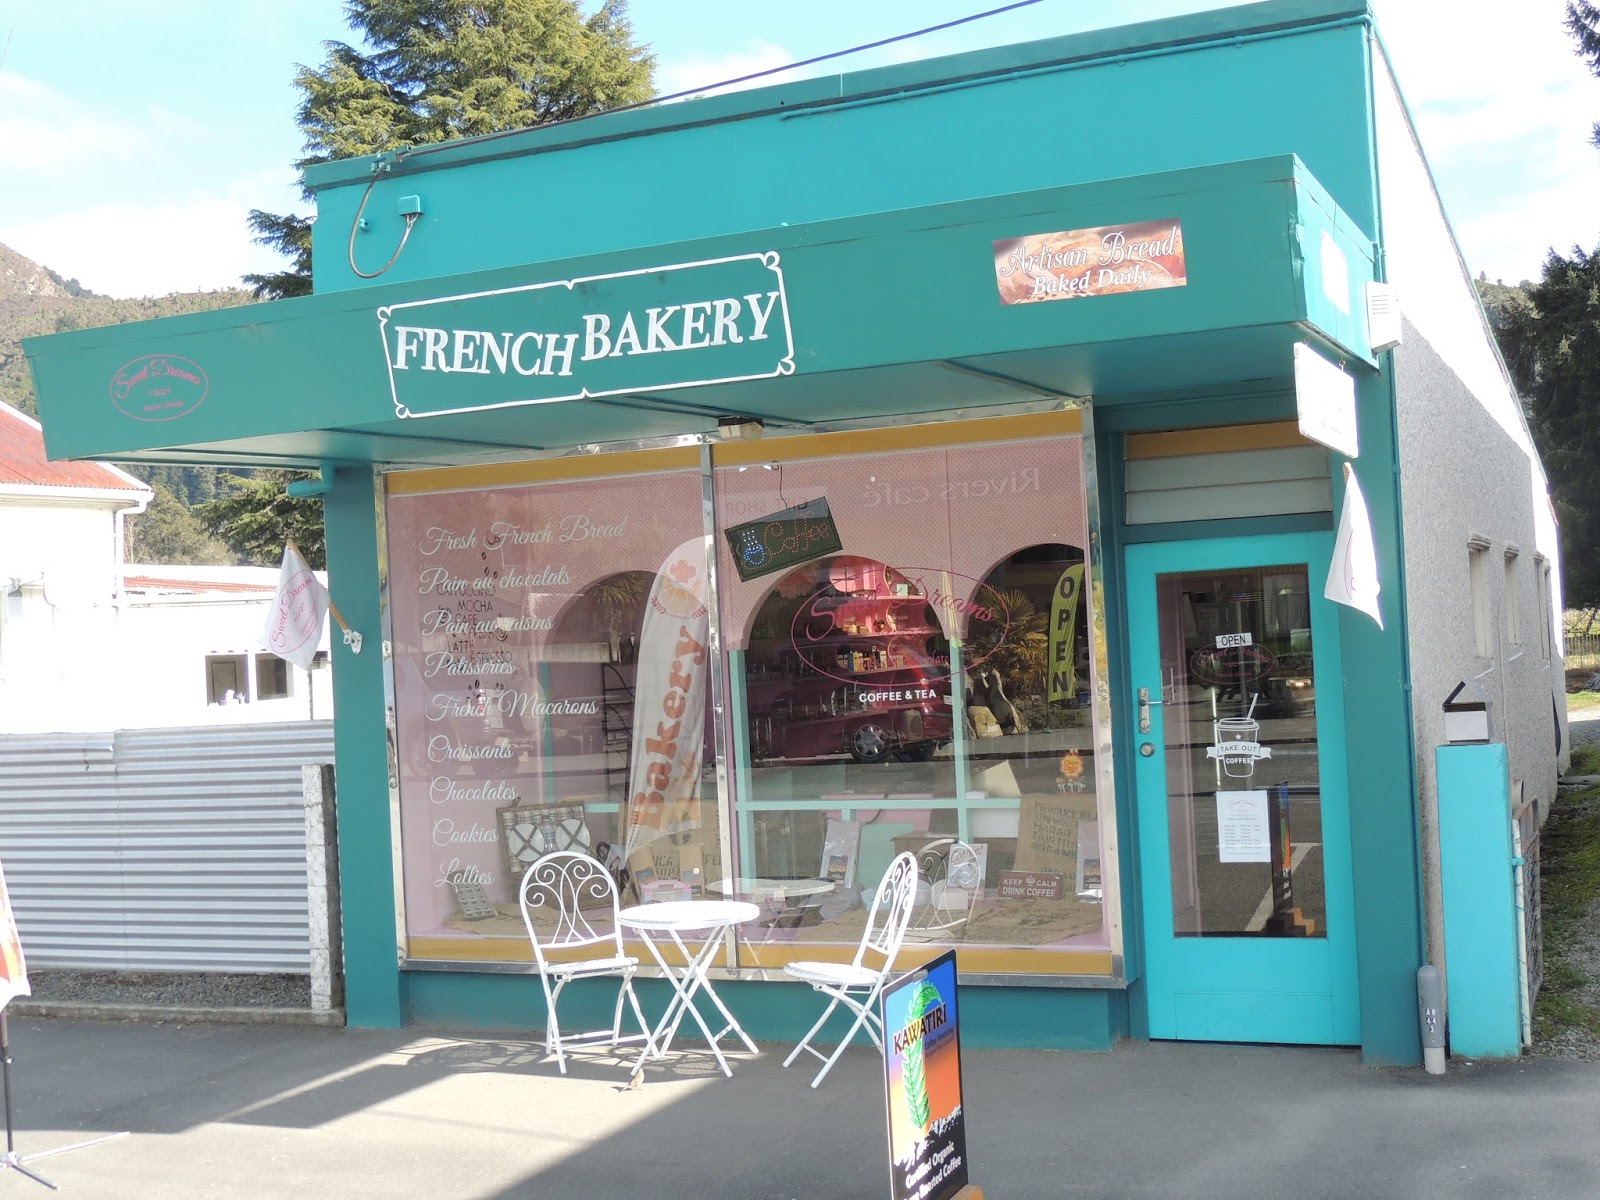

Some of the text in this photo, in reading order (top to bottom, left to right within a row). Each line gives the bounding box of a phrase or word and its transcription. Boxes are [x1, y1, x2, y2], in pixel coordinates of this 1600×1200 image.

[1000, 226, 1177, 277] Artisan Bread
[1033, 265, 1152, 295] Baked Daily
[393, 291, 779, 376] FRENCH BAKERY
[419, 514, 628, 555] Fresh French Bread
[419, 565, 573, 594] Pain au chocolats
[457, 599, 493, 613] MOCHA
[889, 574, 995, 622] Dreams
[422, 609, 469, 636] Pain
[475, 620, 497, 634] au
[498, 616, 556, 632] aisins
[1052, 576, 1076, 694] OPEN
[1221, 634, 1246, 646] OPEN
[424, 651, 515, 677] Patisseries
[425, 690, 599, 721] French Macarons
[859, 689, 937, 702] COFFEE & TEA
[633, 625, 705, 830] Bakery
[428, 734, 514, 762] Croissants
[1220, 744, 1258, 753] TAKE OUT
[1225, 757, 1252, 765] COFFEE
[430, 776, 519, 804] Chocolates
[432, 818, 499, 846] Cookies
[433, 857, 495, 890] Lollies
[1036, 880, 1057, 888] CALM
[1002, 886, 1056, 897] DRINK COFFEE
[893, 1002, 947, 1056] KAWATIRI
[932, 1140, 955, 1166] Organic
[919, 1156, 962, 1199] Roasted Coffee
